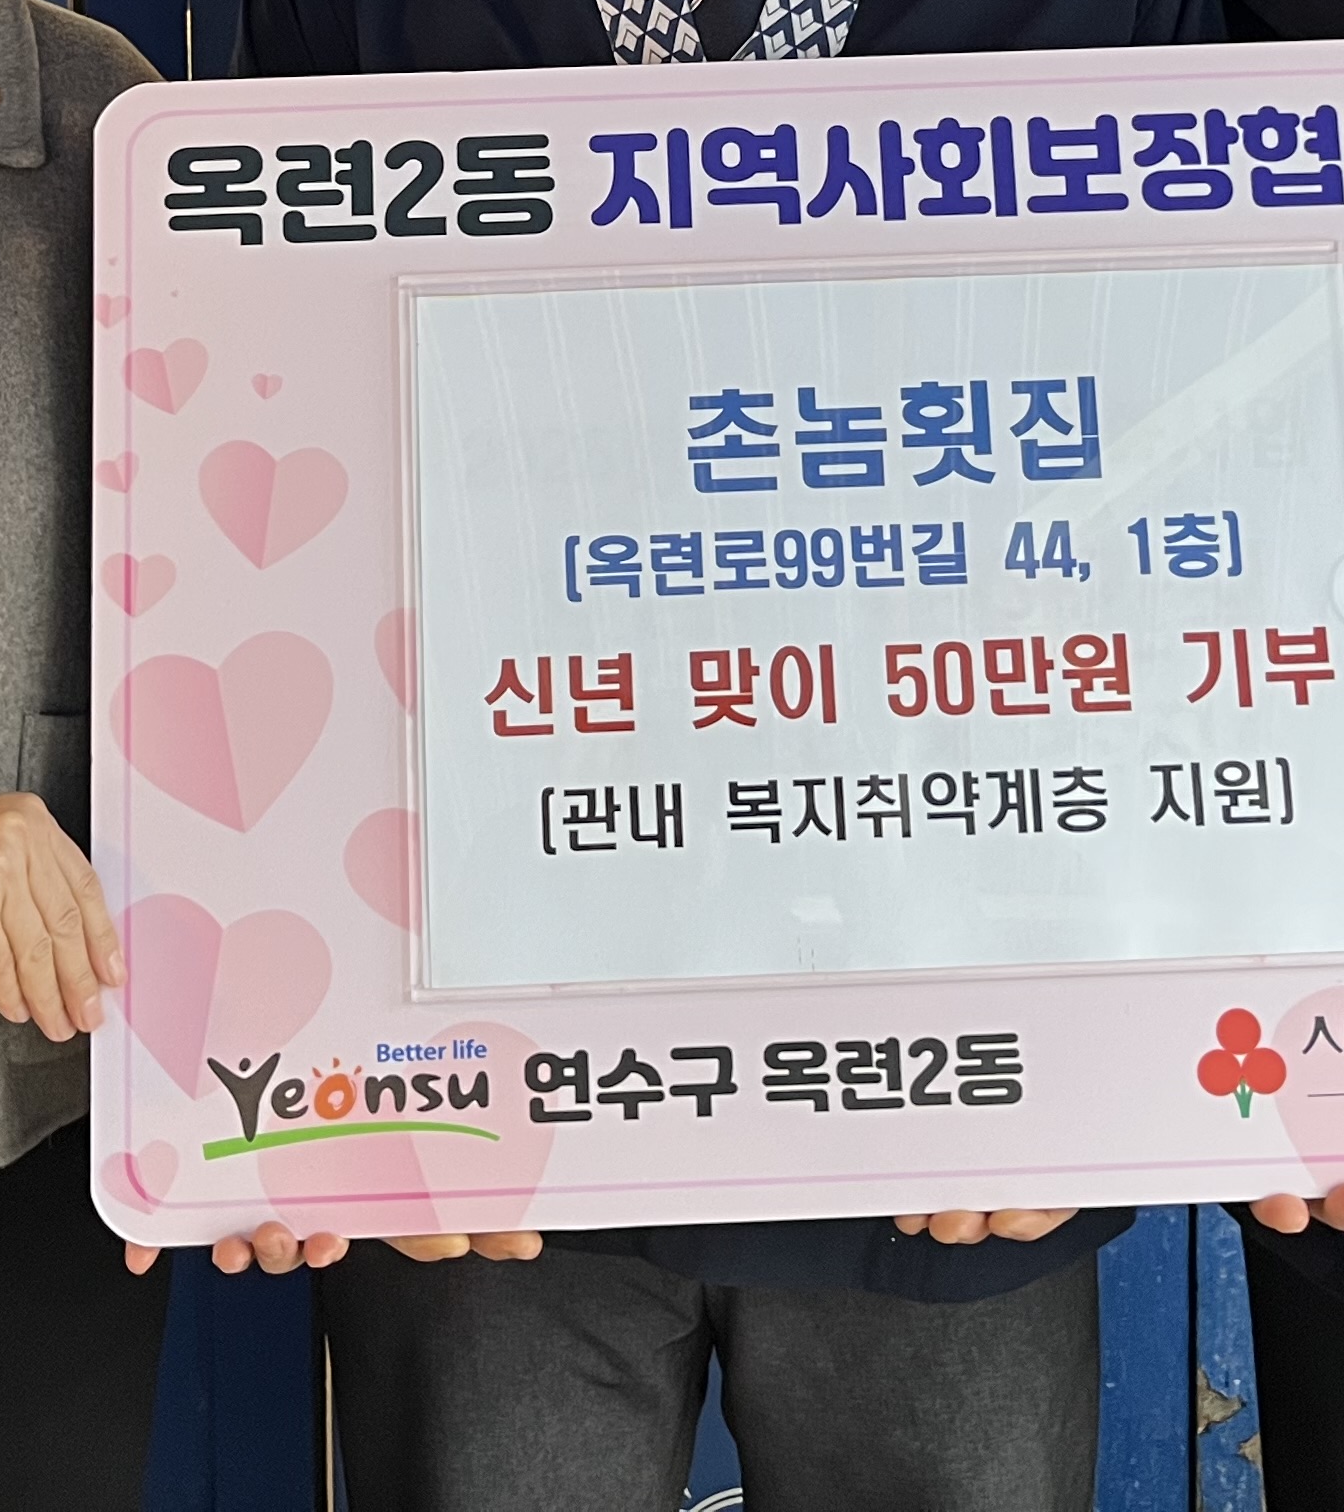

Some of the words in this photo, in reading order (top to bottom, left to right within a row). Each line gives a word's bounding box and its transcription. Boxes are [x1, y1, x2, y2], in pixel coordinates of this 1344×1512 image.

[164, 131, 556, 246] 옥련2동
[686, 374, 1105, 494] 촌놈횟집
[1005, 519, 1093, 586] 44,
[483, 650, 637, 738] 신년
[690, 643, 839, 731] 맞이
[885, 631, 1134, 720] 50만원
[1182, 625, 1337, 709] 기부
[726, 765, 1111, 845] 복지취약계층
[375, 1041, 447, 1064] Better
[452, 1038, 488, 1063] life
[523, 1045, 739, 1125] 연수구
[760, 1032, 1024, 1115] 옥련2동
[207, 1052, 491, 1142] Yeonsu
